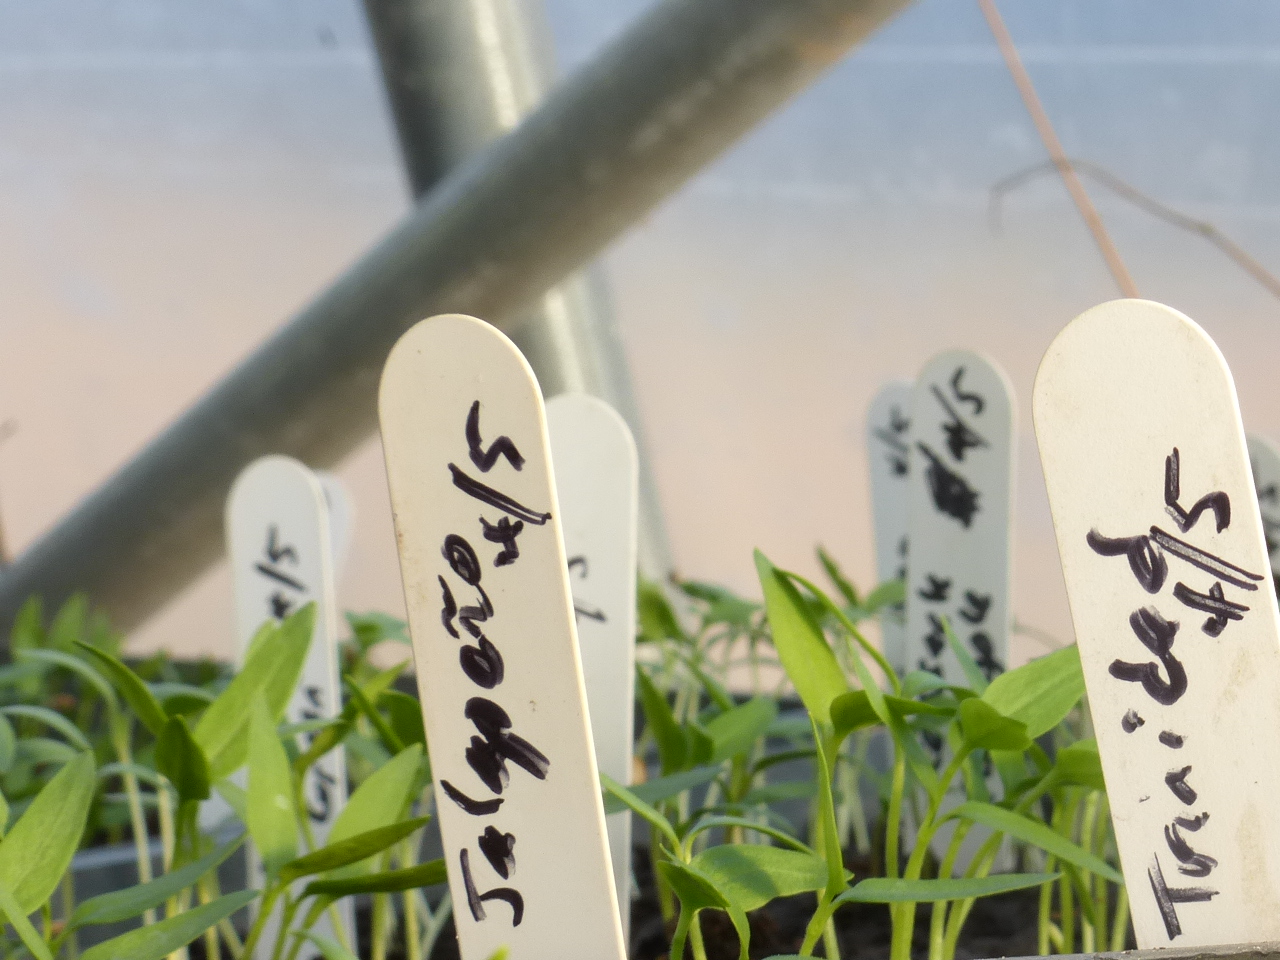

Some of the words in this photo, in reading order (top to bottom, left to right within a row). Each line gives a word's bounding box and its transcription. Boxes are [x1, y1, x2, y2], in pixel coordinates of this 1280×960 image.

[446, 400, 551, 567] 4/5
[929, 365, 991, 463] 4/5
[1149, 446, 1264, 638] 4/5
[437, 534, 550, 928] Jalapeño
